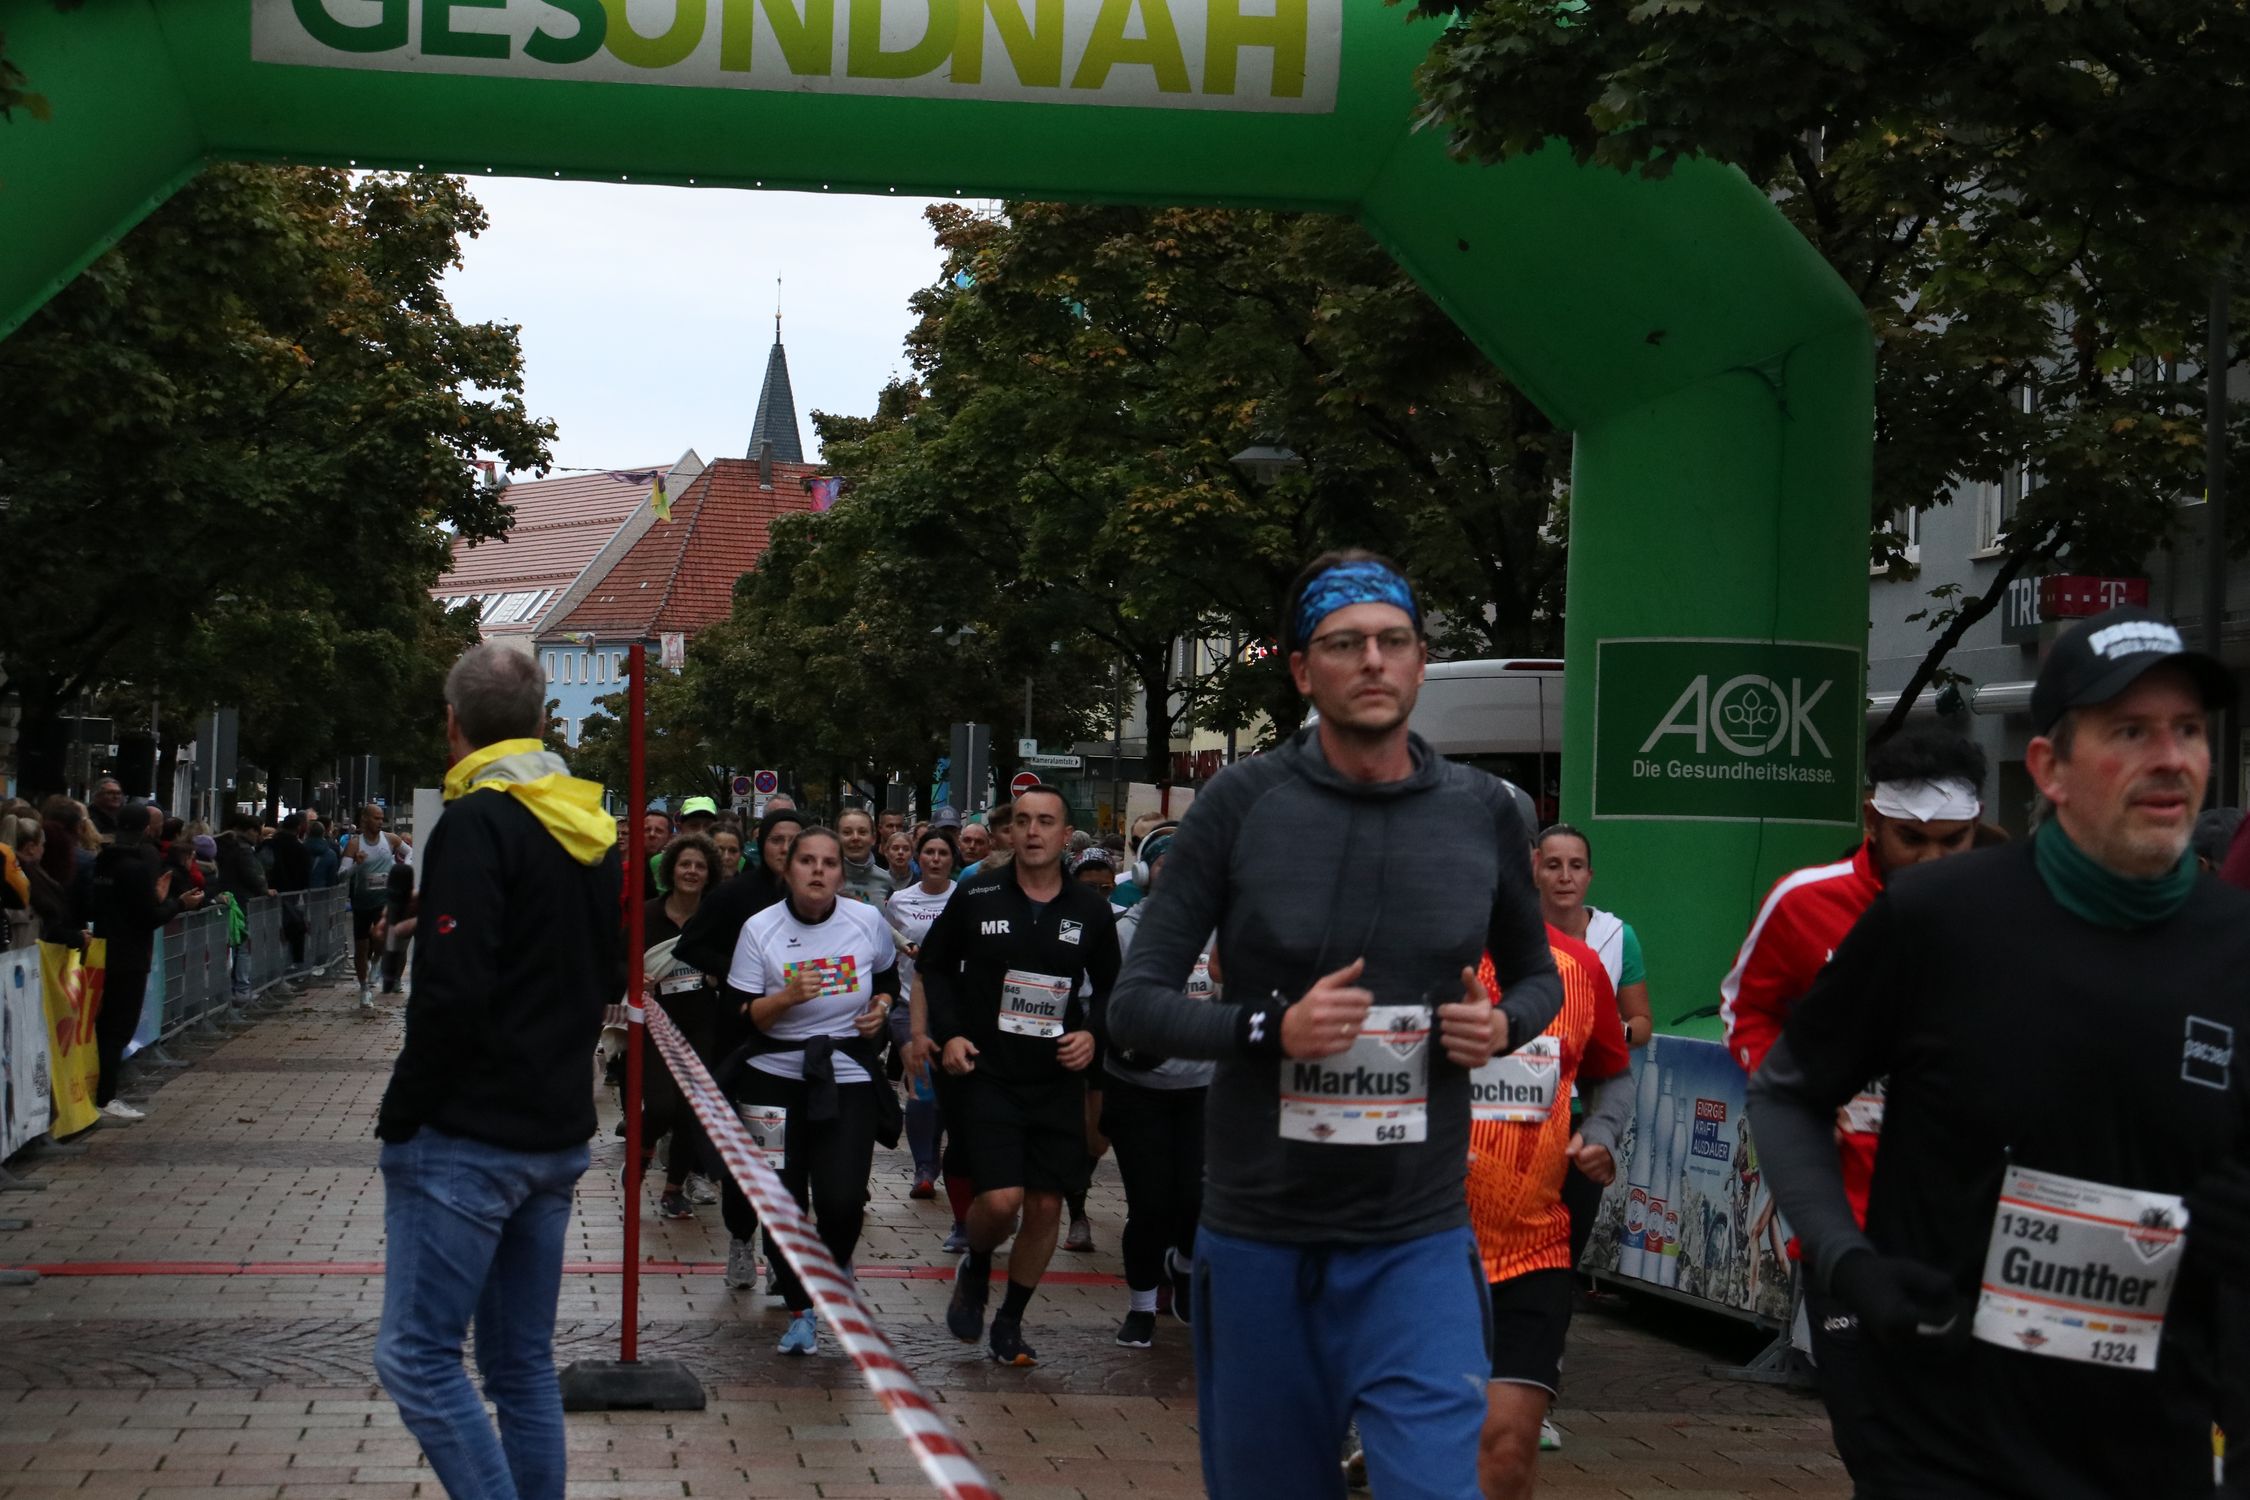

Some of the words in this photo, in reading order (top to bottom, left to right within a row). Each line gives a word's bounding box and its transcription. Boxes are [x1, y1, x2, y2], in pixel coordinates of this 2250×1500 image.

[2009, 574, 2044, 627] TRE
[1638, 674, 1833, 759] AOK
[1633, 760, 1661, 778] Die
[1667, 761, 1836, 783] Gesundheitskasse.
[968, 884, 1001, 896] uhlsport
[980, 919, 1011, 935] MR
[1004, 985, 1021, 995] 645
[1011, 997, 1056, 1016] Moritz
[1040, 1028, 1053, 1036] 645
[1293, 1063, 1411, 1095] Markus
[1471, 1080, 1543, 1104] ochen
[1697, 1101, 1725, 1120] ENERGIE
[1376, 1125, 1406, 1141] 643
[1694, 1120, 1717, 1137] KRAFT
[1693, 1140, 1728, 1159] AUSDAUER
[2002, 1214, 2059, 1244] 1324
[2001, 1246, 2156, 1307] Gunther
[2091, 1340, 2138, 1363] 1324
